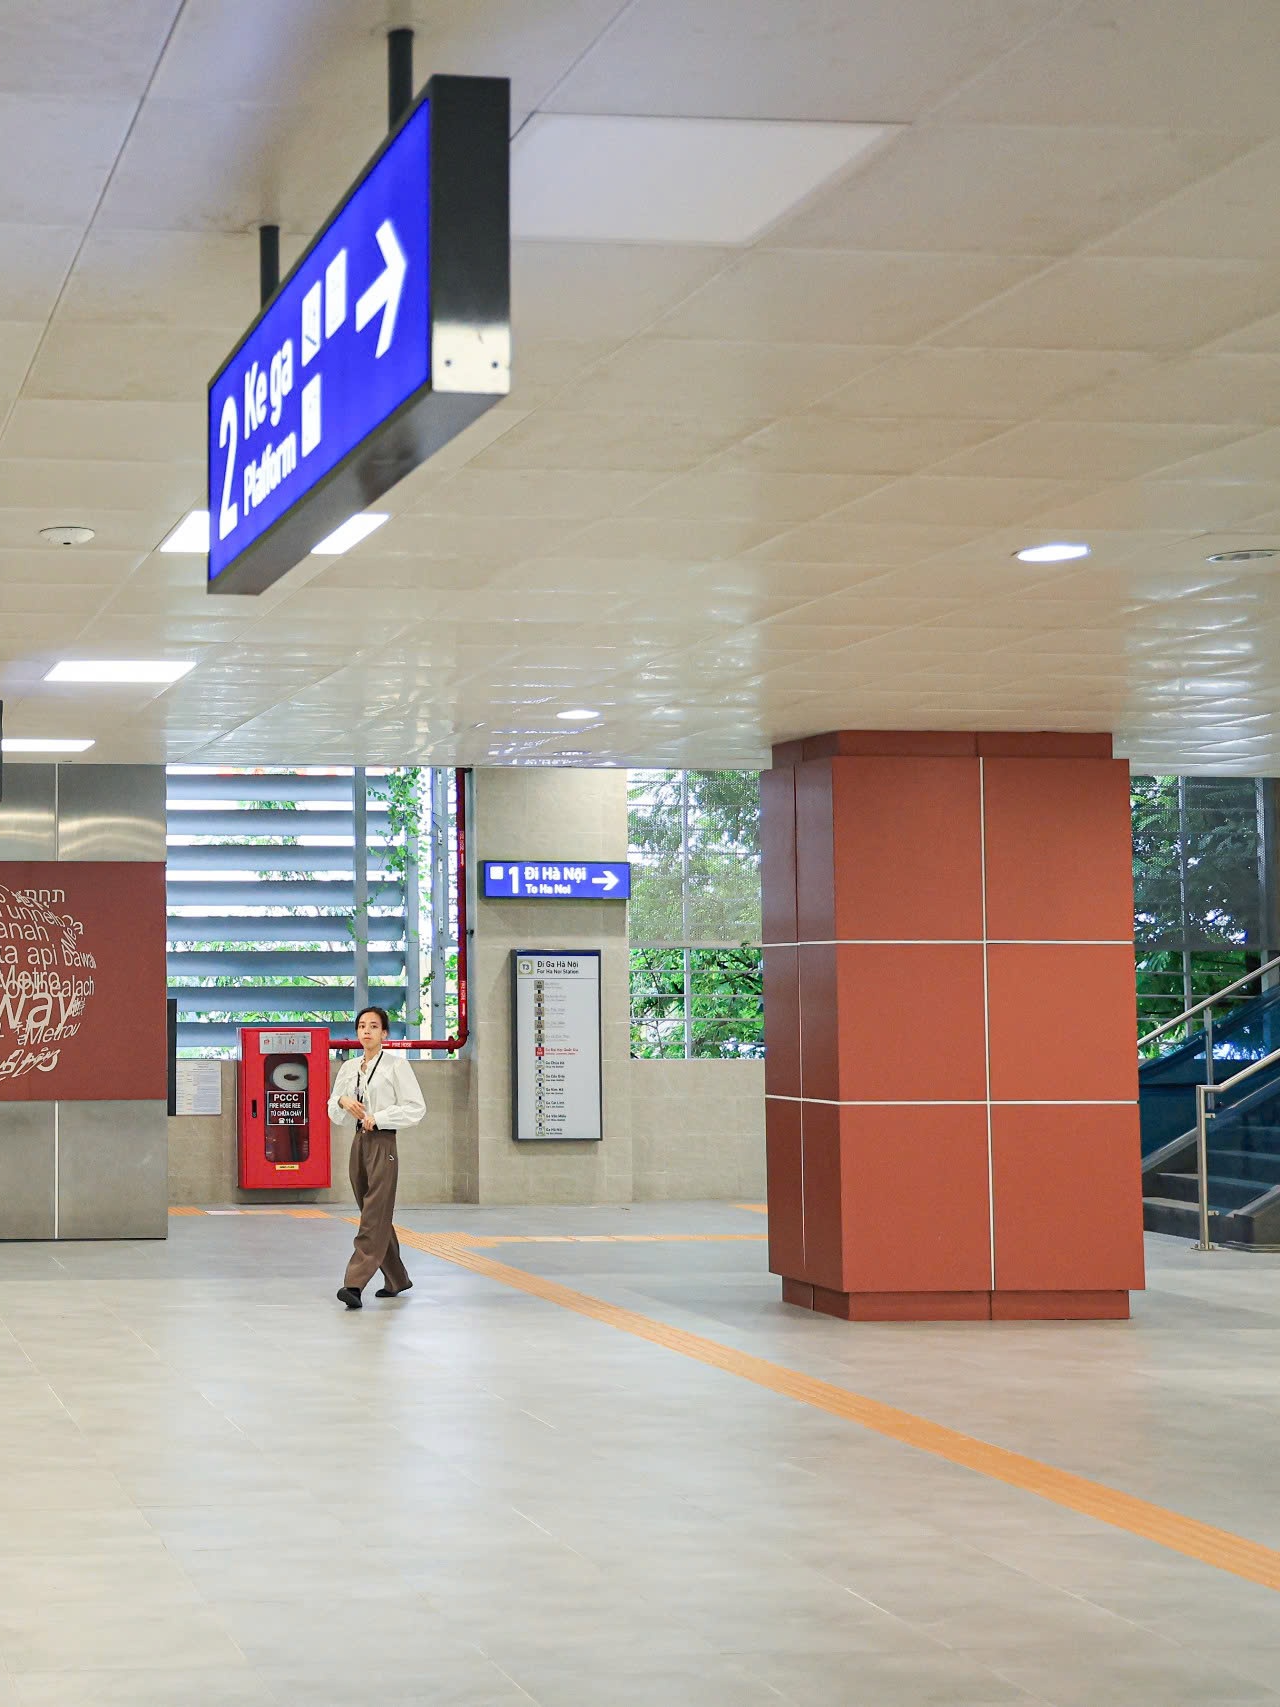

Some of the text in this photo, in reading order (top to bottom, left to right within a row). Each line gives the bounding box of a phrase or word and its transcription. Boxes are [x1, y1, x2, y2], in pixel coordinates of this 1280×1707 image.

[244, 338, 293, 440] Ke ga
[219, 395, 238, 540] 2
[244, 431, 297, 517] Platform
[508, 866, 519, 894] 1
[524, 867, 587, 883] Đi Hà Nội
[525, 884, 571, 894] To Ha Noi
[27, 944, 58, 969] api
[567, 961, 579, 970] Nội
